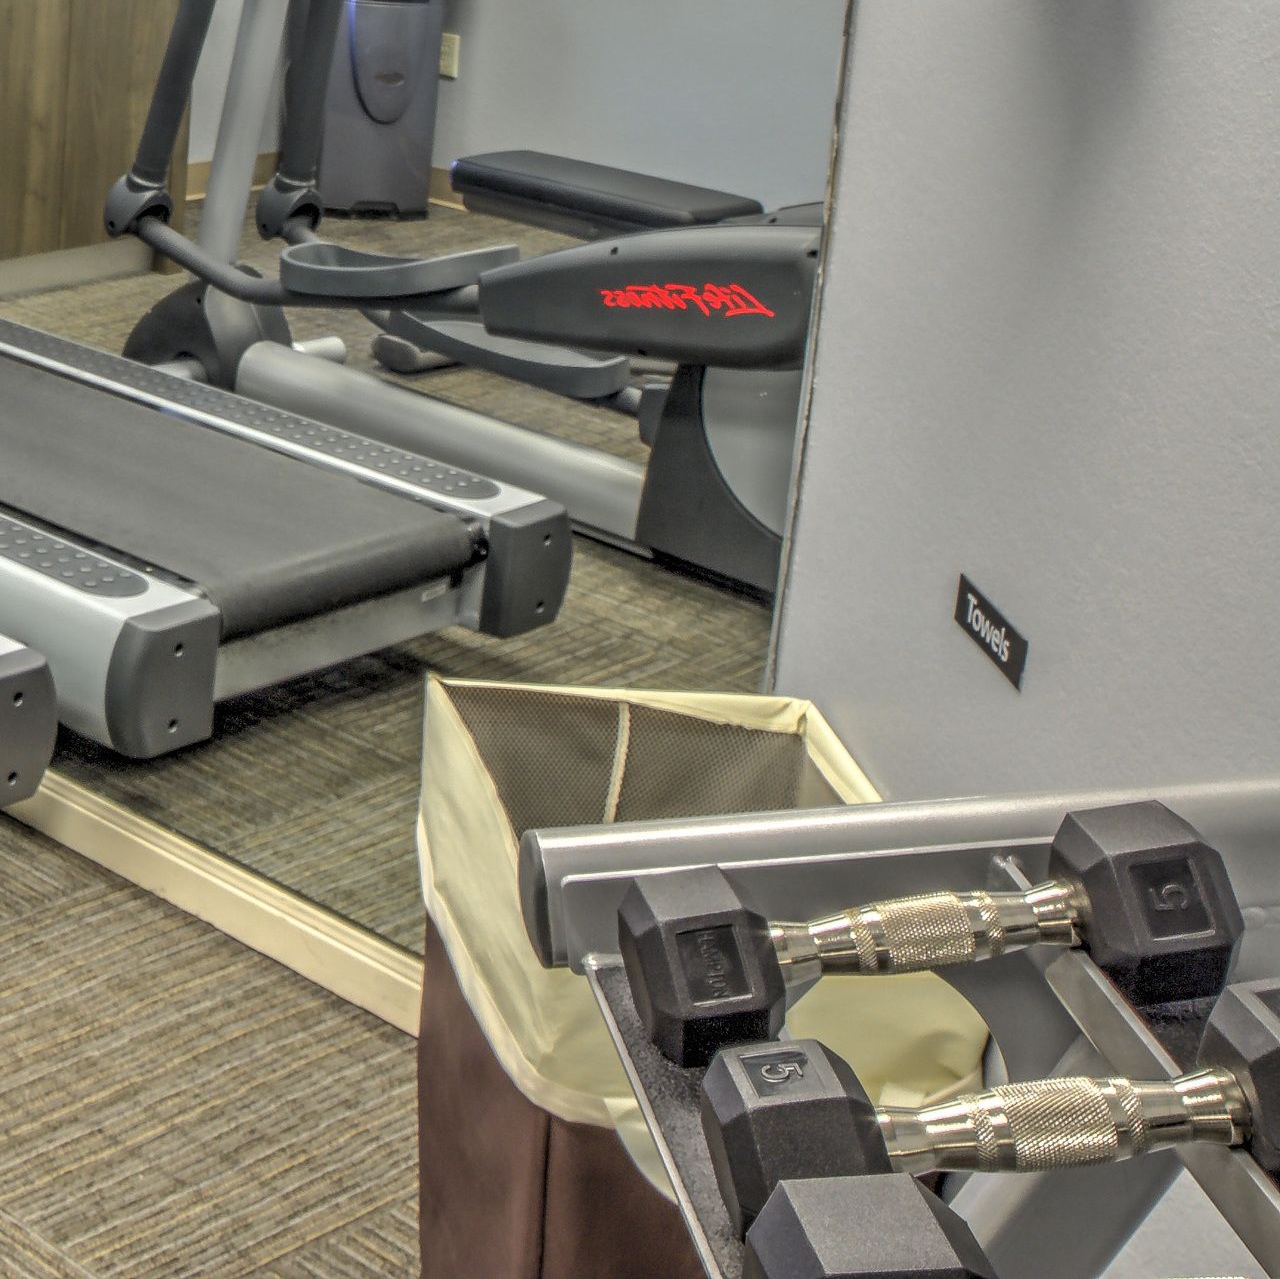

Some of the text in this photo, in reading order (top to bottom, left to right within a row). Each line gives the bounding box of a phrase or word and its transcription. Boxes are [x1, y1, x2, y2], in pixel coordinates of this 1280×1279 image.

[965, 592, 1011, 663] Towels
[1148, 883, 1189, 911] 5
[696, 929, 730, 998] HAMPTON
[760, 1061, 804, 1084] 5
